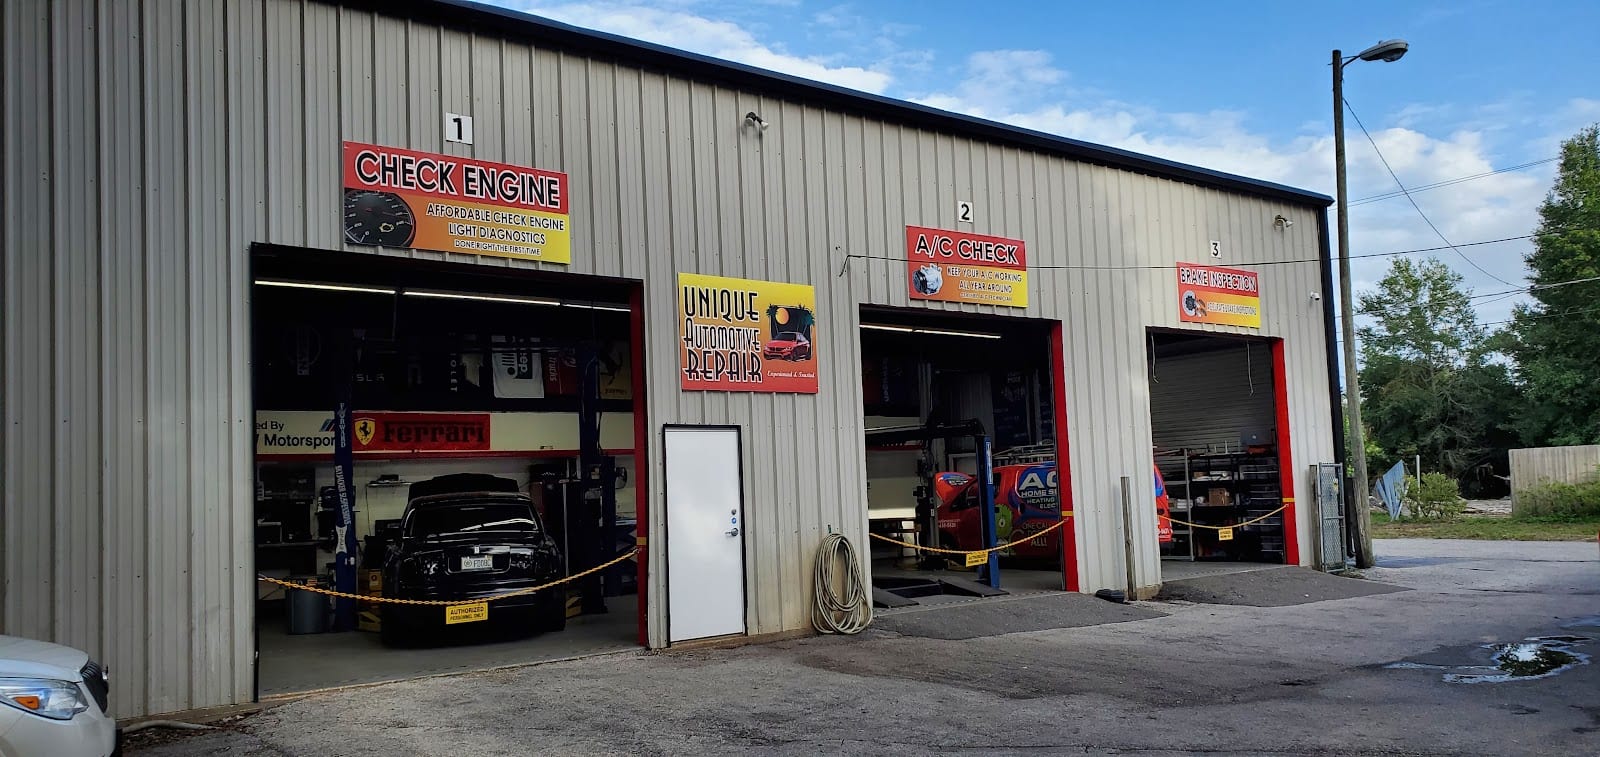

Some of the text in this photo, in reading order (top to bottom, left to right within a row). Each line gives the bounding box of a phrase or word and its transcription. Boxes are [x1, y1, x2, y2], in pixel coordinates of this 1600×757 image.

[453, 118, 463, 140] 1
[355, 150, 561, 209] CHECK ENGINE
[426, 202, 565, 231] AFFORDABLE CHECK ENGINE
[961, 203, 970, 220] 2
[448, 222, 546, 245] LIGHT DIAGNOSTICS
[455, 240, 541, 256] DONE RIGHT THE FIRST TIME
[915, 234, 1019, 265] A/C CHECK
[1212, 242, 1219, 256] 3
[946, 266, 961, 276] KEEP
[962, 267, 979, 278] YOUR
[994, 272, 1022, 282] WORKING
[1180, 267, 1257, 293] BRAKE INSPECTION
[959, 280, 1013, 294] ALL YEAR AROUND
[683, 285, 760, 323] UNIQUE
[683, 317, 761, 352] AUTOMOTIVE
[683, 348, 763, 383] REPAIR
[271, 421, 285, 432] By
[382, 421, 485, 443] Ferrari
[264, 433, 336, 450] Motorspor
[1021, 489, 1046, 498] HOME
[450, 606, 484, 615] AUTHORIZED
